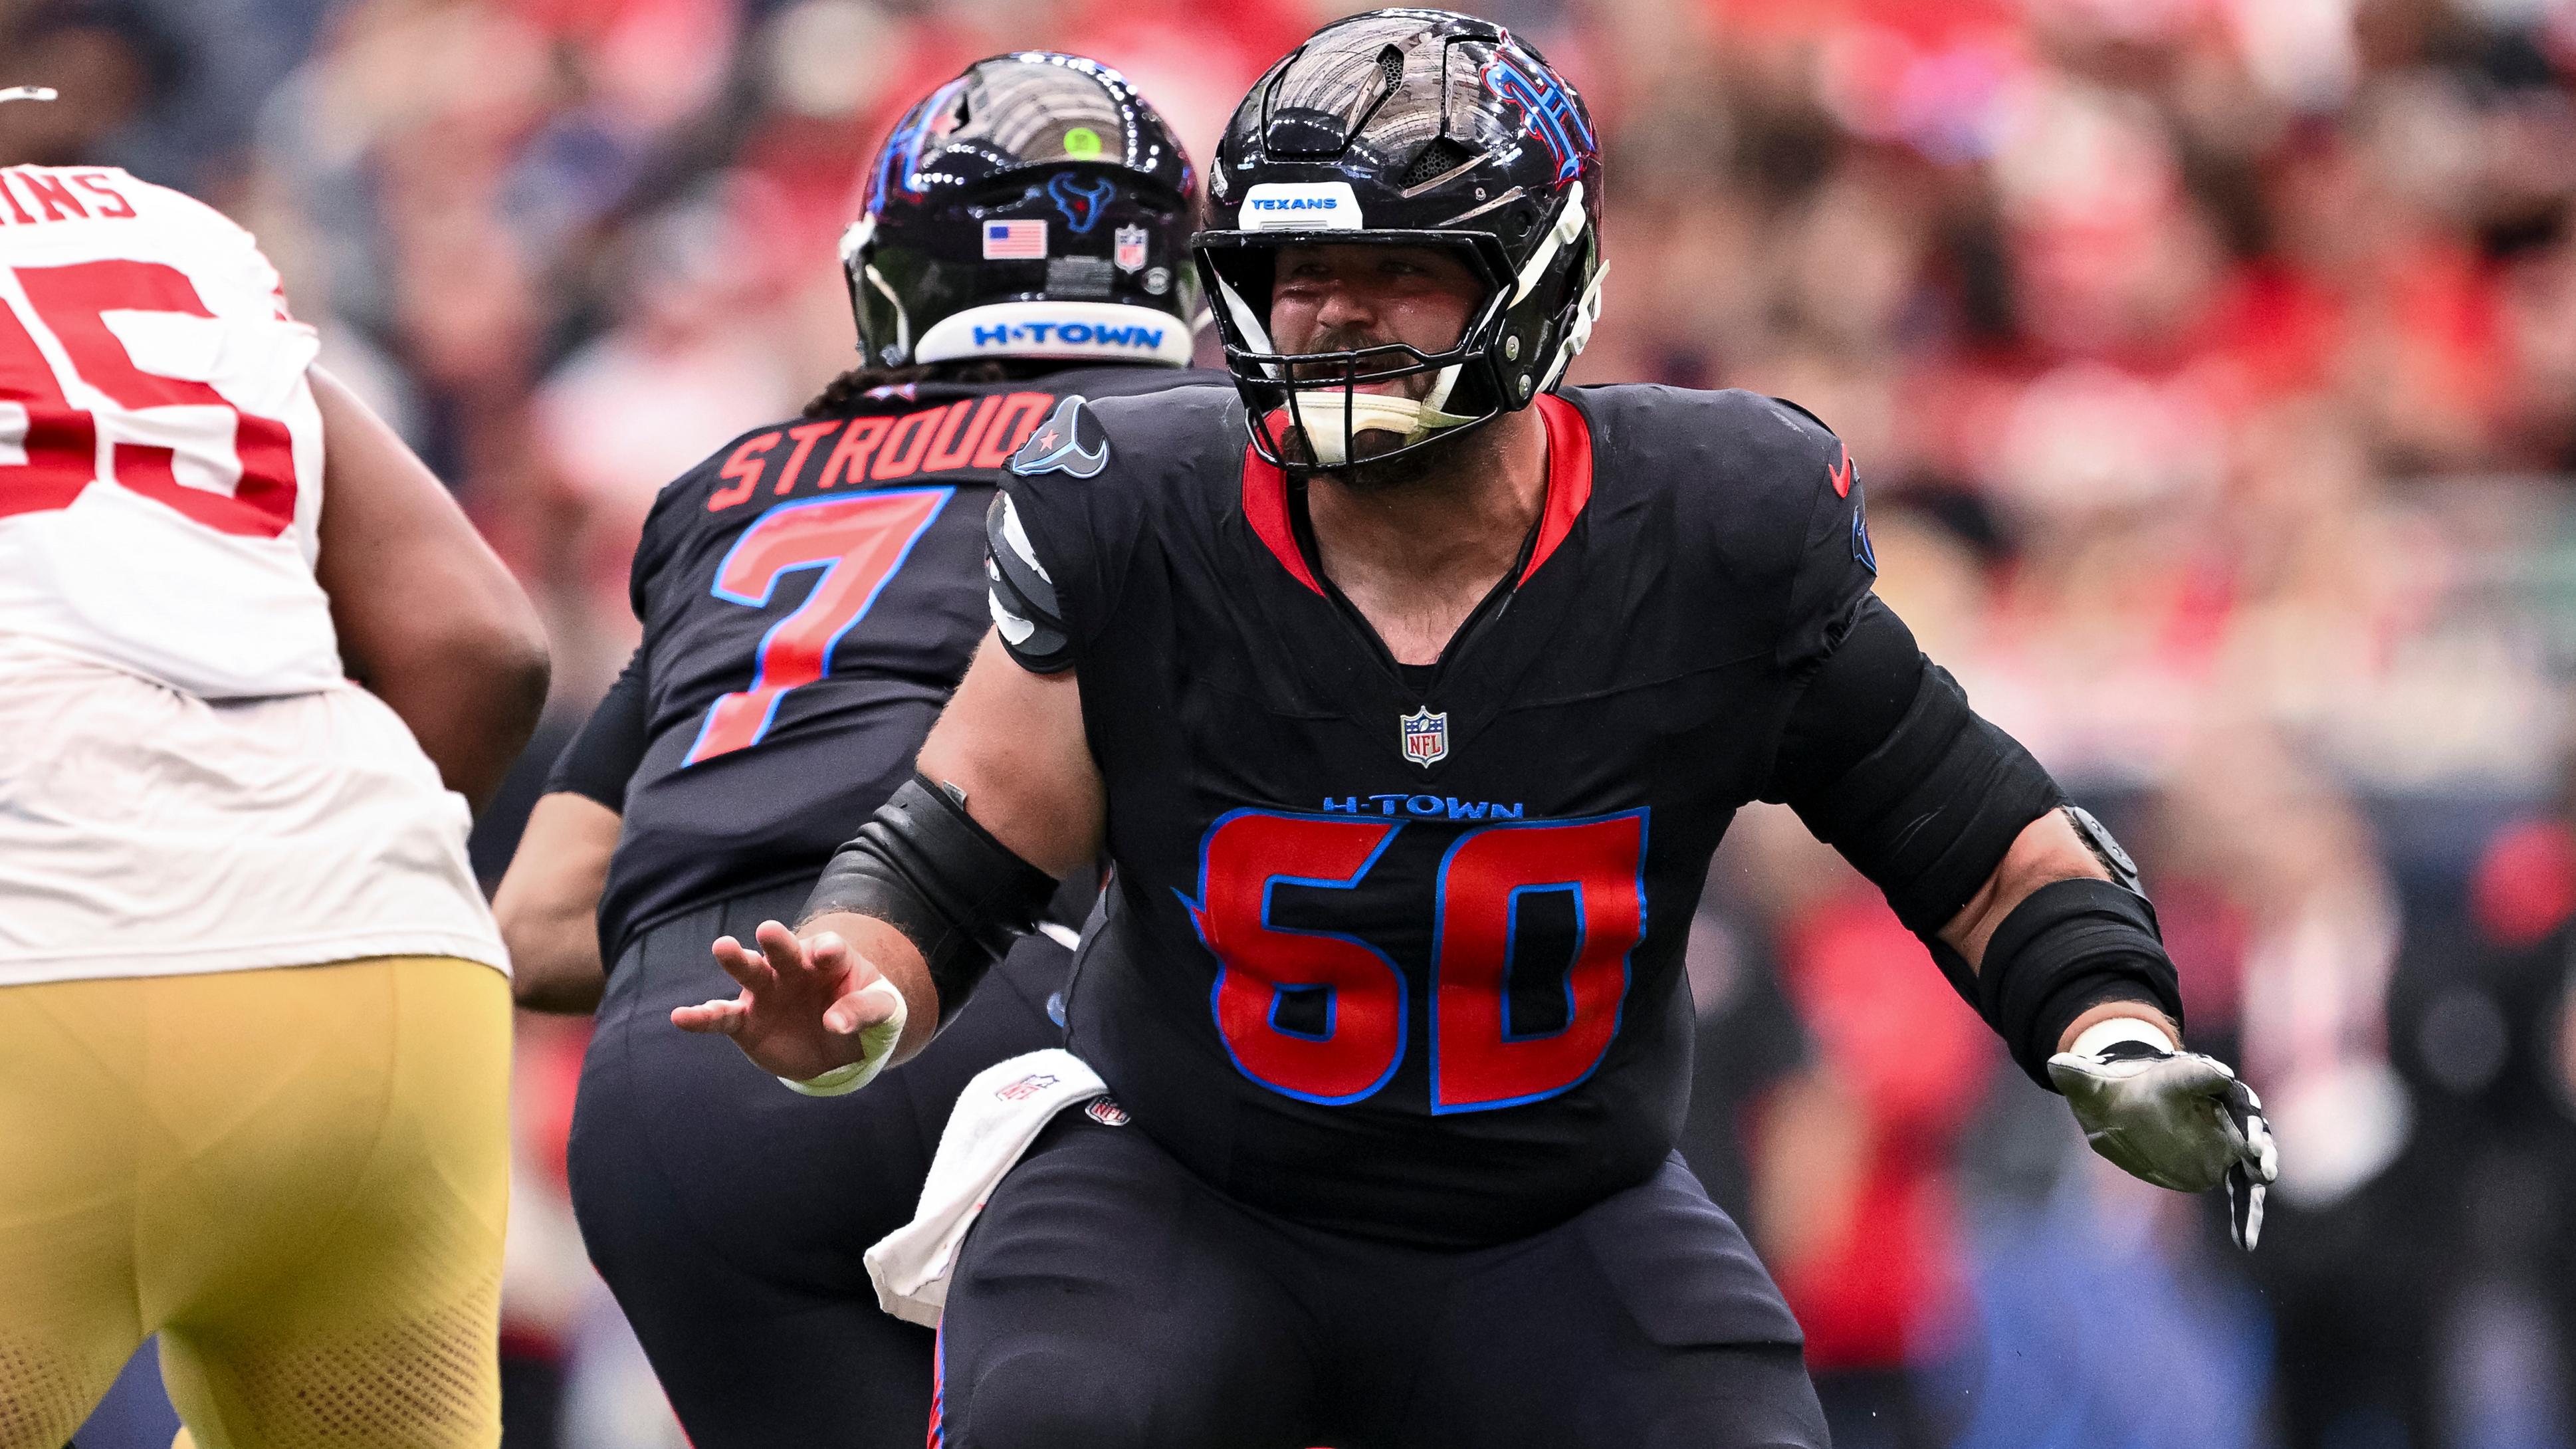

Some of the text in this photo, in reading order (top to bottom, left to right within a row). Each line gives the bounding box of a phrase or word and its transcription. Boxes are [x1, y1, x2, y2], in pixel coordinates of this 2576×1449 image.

[0, 171, 137, 225] INS
[1251, 198, 1337, 209] TEXANS
[707, 391, 1055, 512] STROUD
[682, 486, 956, 766] 7
[1409, 734, 1441, 757] NFL
[1323, 794, 1523, 819] H-TOWN
[1170, 806, 1650, 1115] 60
[1095, 1103, 1125, 1121] NFL
